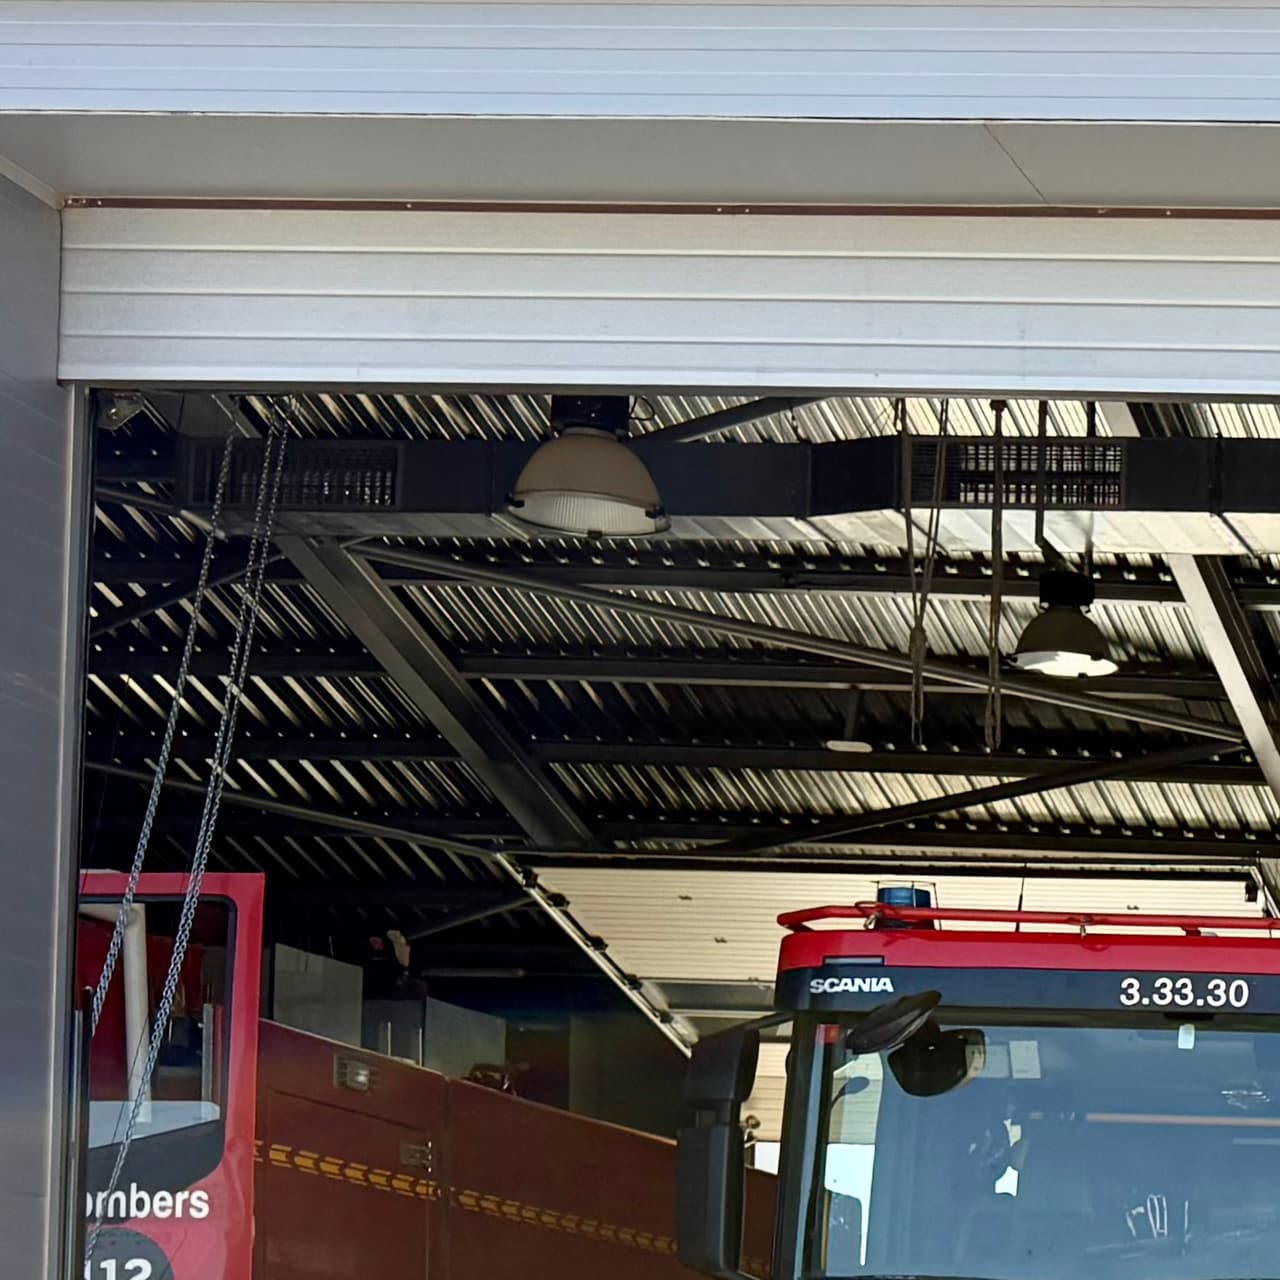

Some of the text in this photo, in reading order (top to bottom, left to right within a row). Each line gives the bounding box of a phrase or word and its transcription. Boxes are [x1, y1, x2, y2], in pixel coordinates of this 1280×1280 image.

[809, 977, 895, 994] SCANIA
[1119, 977, 1250, 1008] 3.33.30
[86, 1182, 210, 1219] mbers
